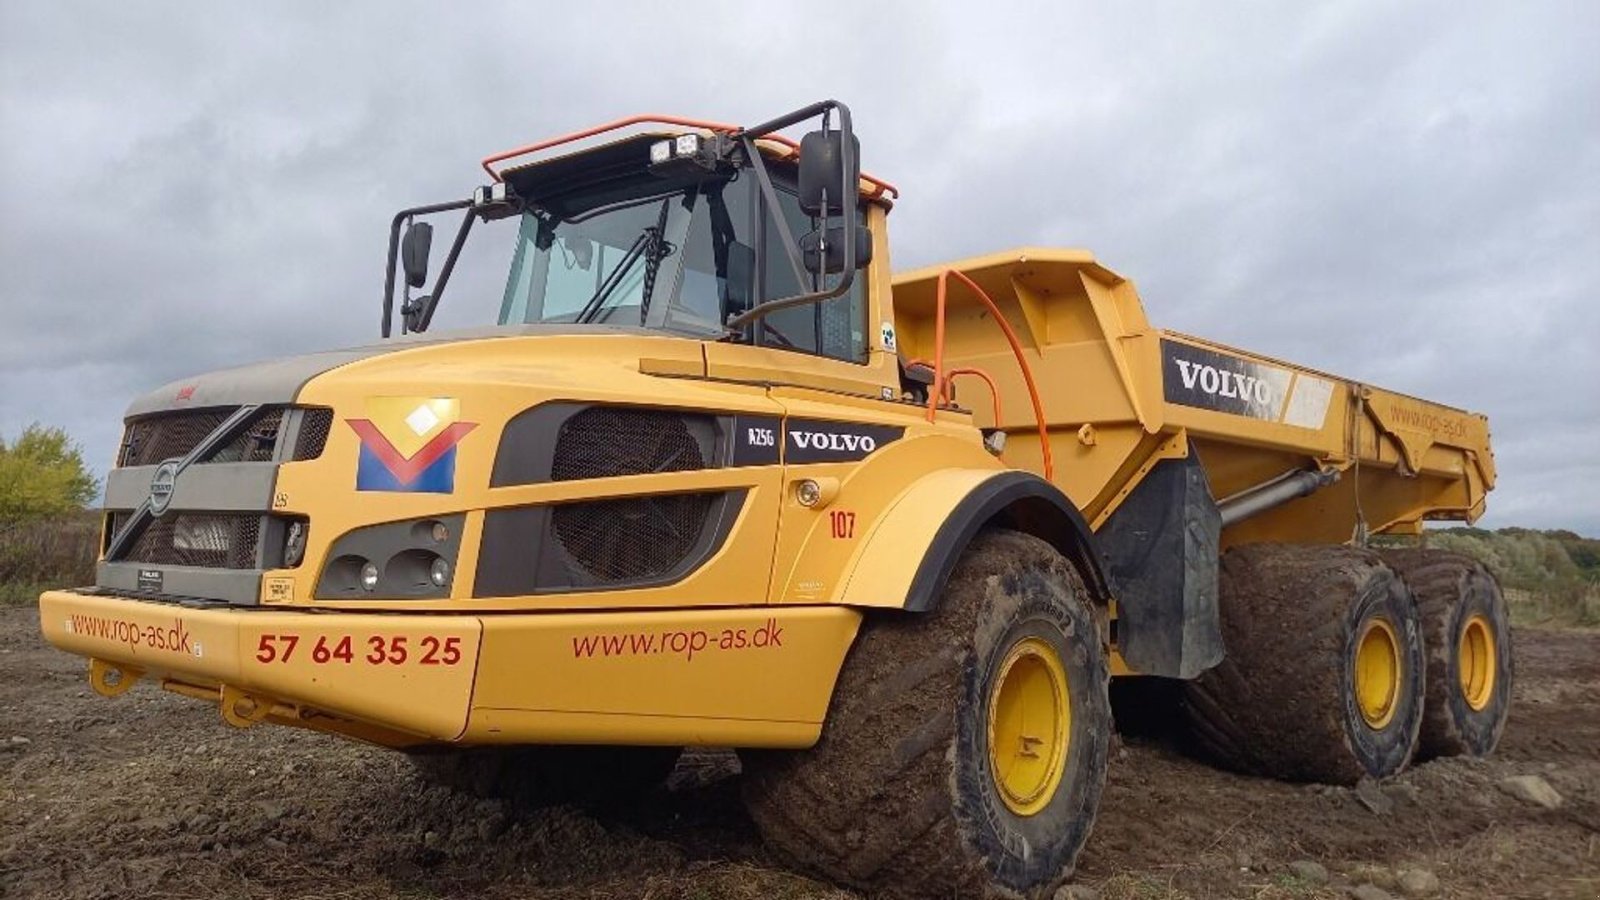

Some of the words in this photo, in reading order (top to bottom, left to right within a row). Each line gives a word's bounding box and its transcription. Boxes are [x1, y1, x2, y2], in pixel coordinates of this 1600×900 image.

[1175, 358, 1271, 404] VOLVO
[748, 428, 775, 446] A25G
[789, 431, 876, 452] VOLVO
[830, 510, 856, 539] 107
[71, 614, 191, 654] www.rop-as.dk
[256, 634, 300, 664] 57
[312, 635, 354, 664] 64
[366, 635, 408, 665] 35
[419, 636, 461, 665] 25
[572, 617, 784, 662] www.rop-as.dk
